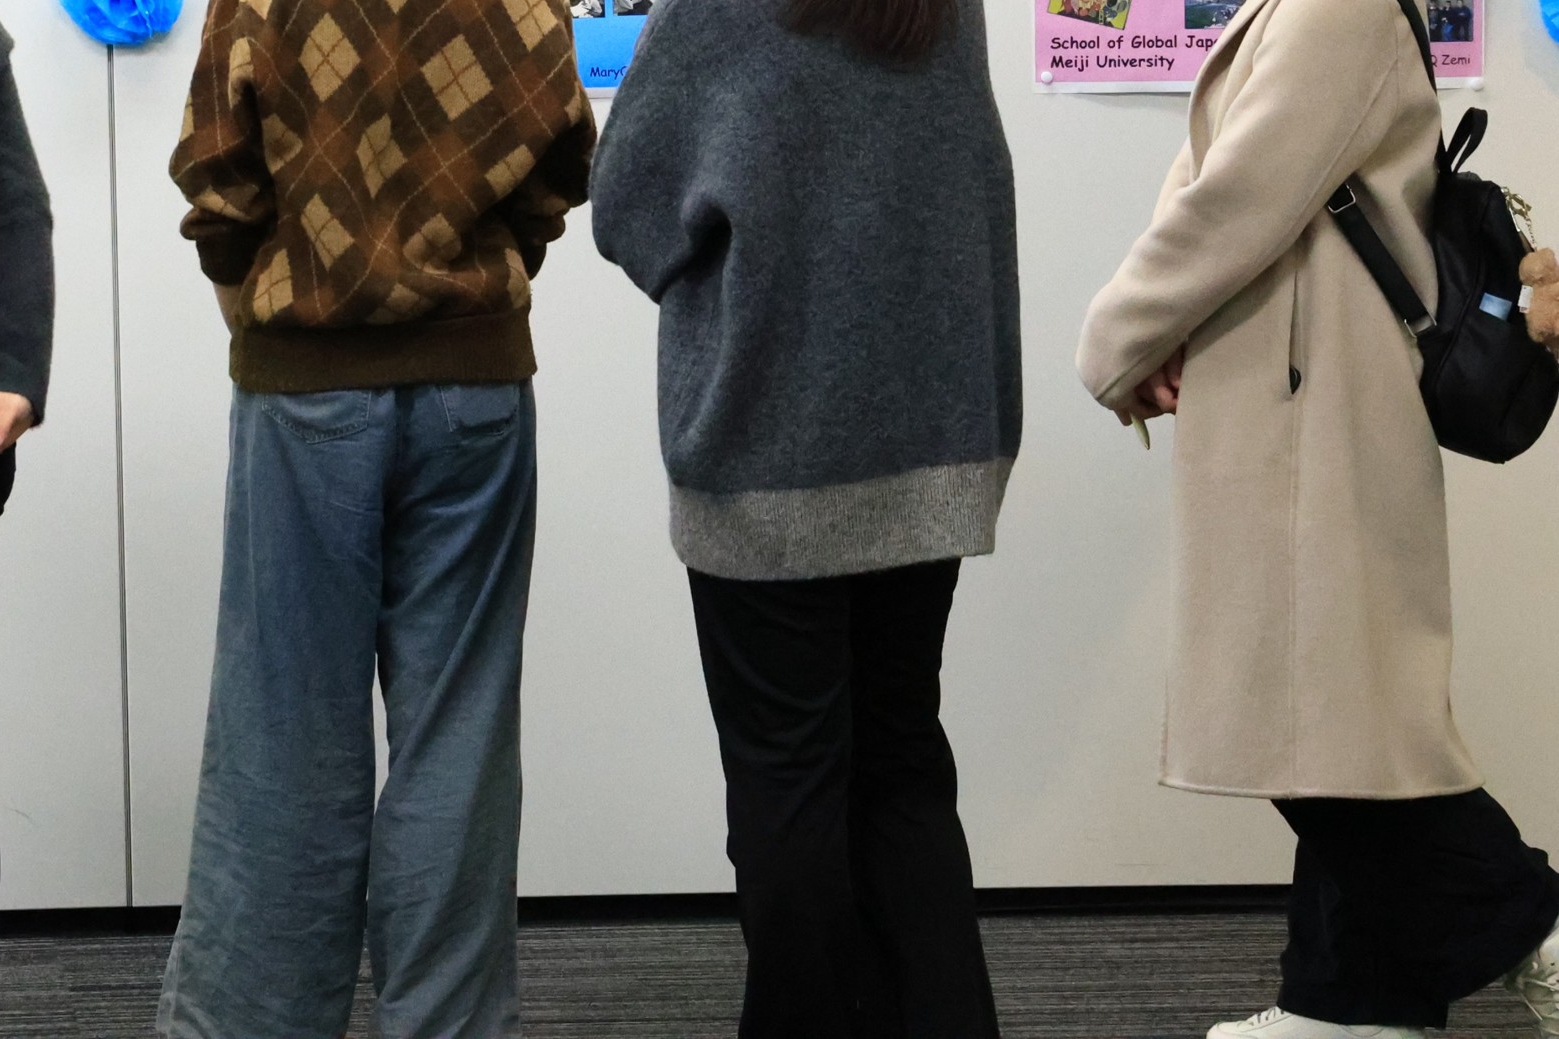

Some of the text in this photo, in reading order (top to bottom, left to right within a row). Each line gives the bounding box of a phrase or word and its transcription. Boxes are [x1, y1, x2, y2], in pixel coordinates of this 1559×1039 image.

[1050, 35, 1178, 50] School of Global
[1050, 55, 1175, 72] Meiji University
[1441, 54, 1471, 66] Zemi
